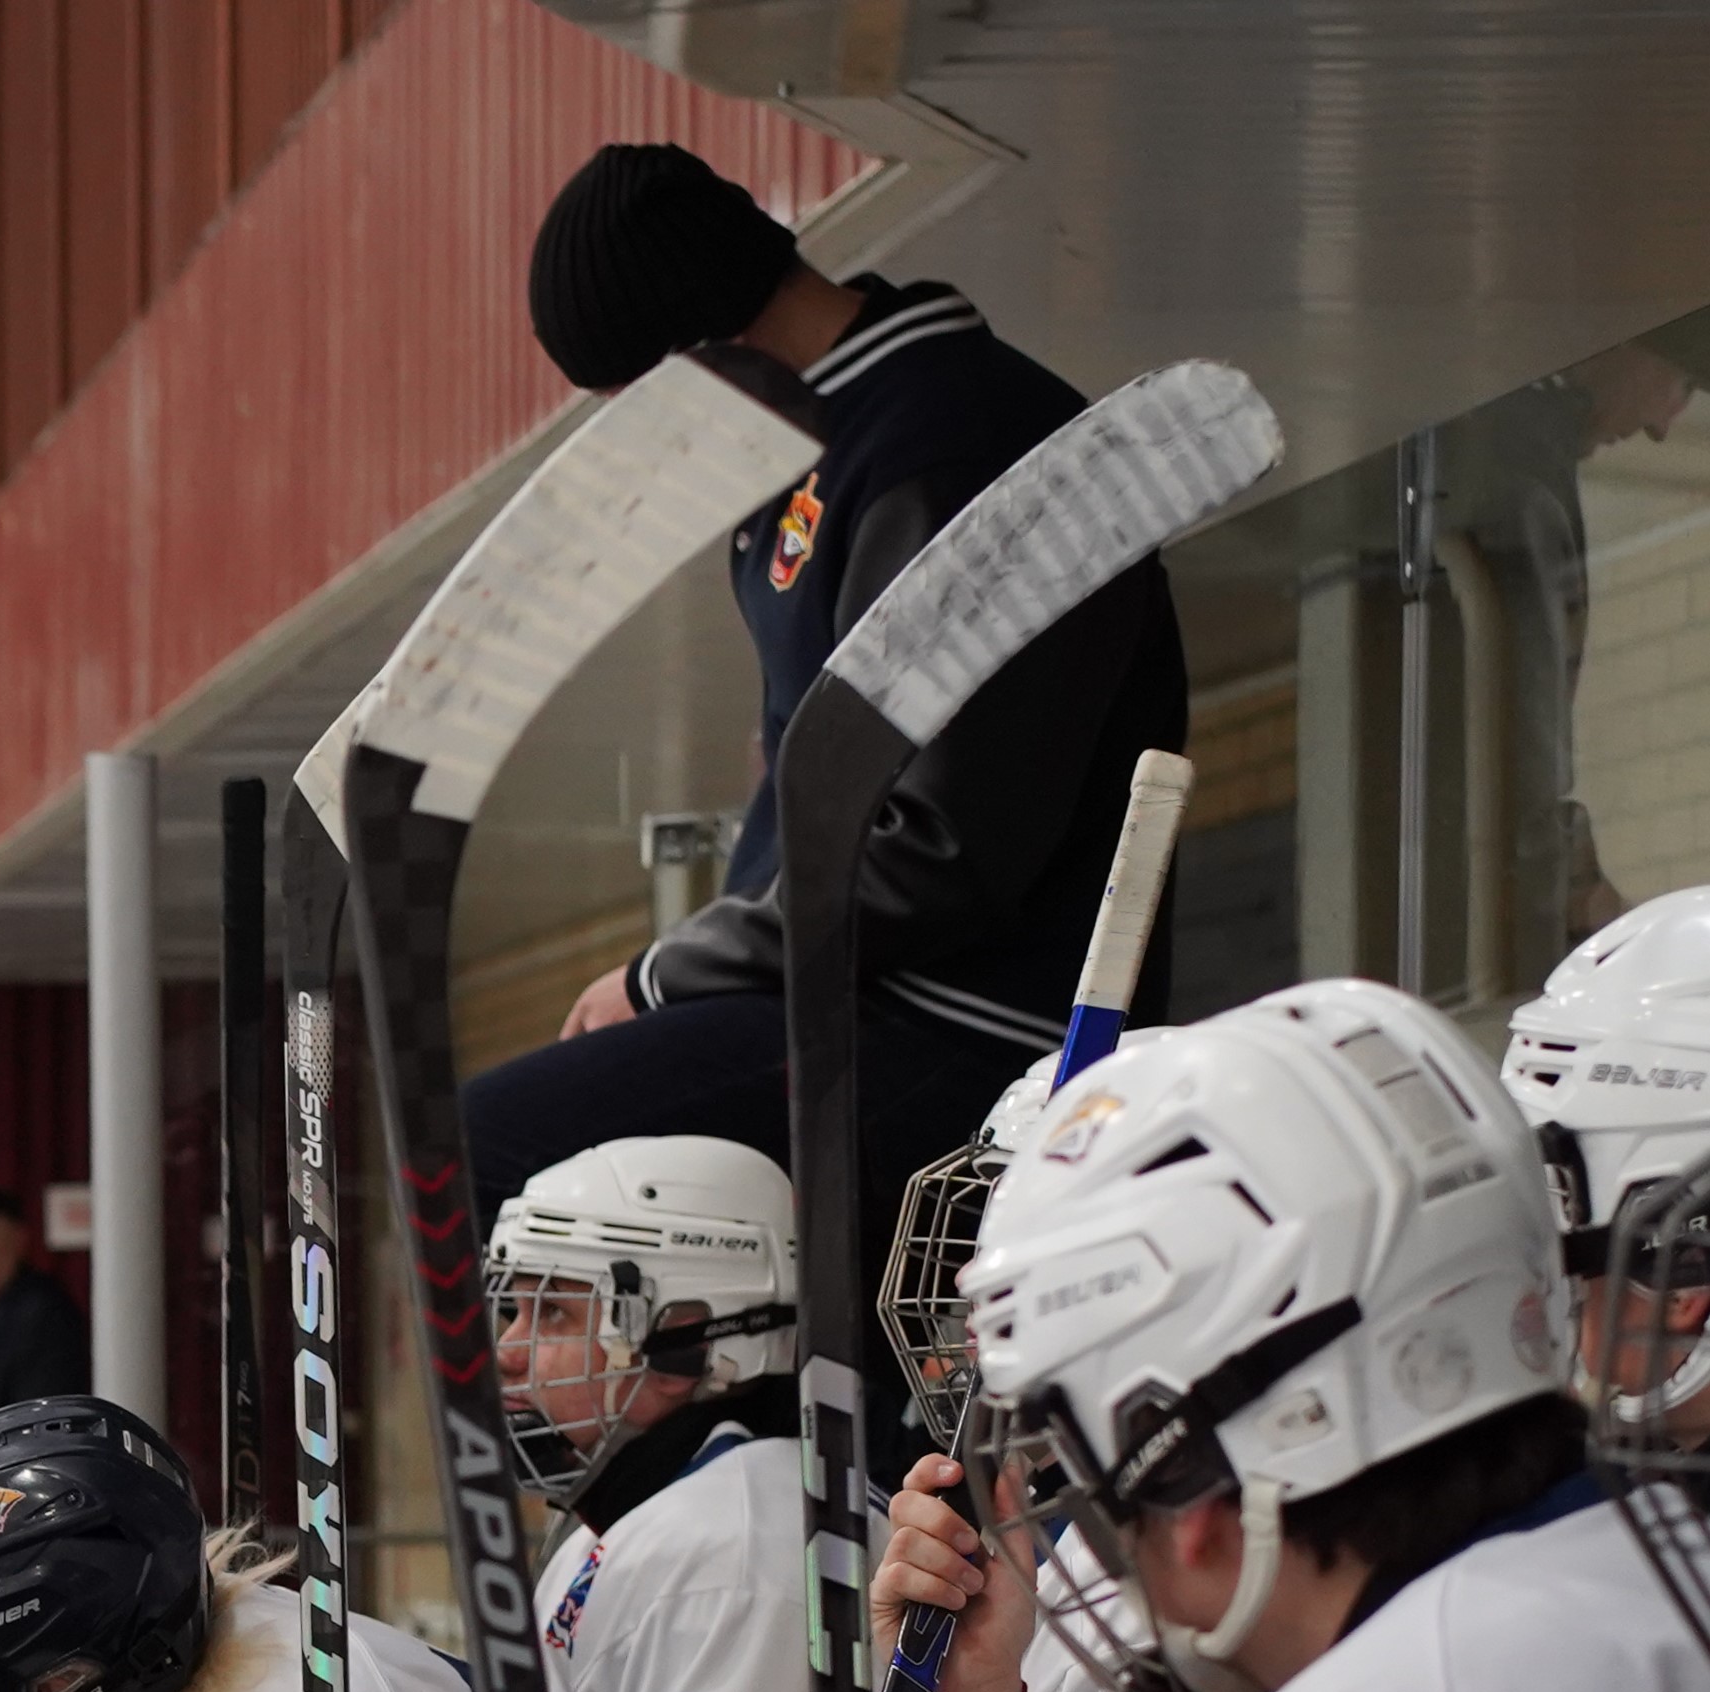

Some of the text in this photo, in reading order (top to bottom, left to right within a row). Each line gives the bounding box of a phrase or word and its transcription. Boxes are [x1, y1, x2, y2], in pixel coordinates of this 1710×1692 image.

[298, 990, 315, 1082] classic
[1587, 1063, 1708, 1093] BAUER
[299, 1088, 323, 1163] SPR
[670, 1230, 759, 1252] BAUER
